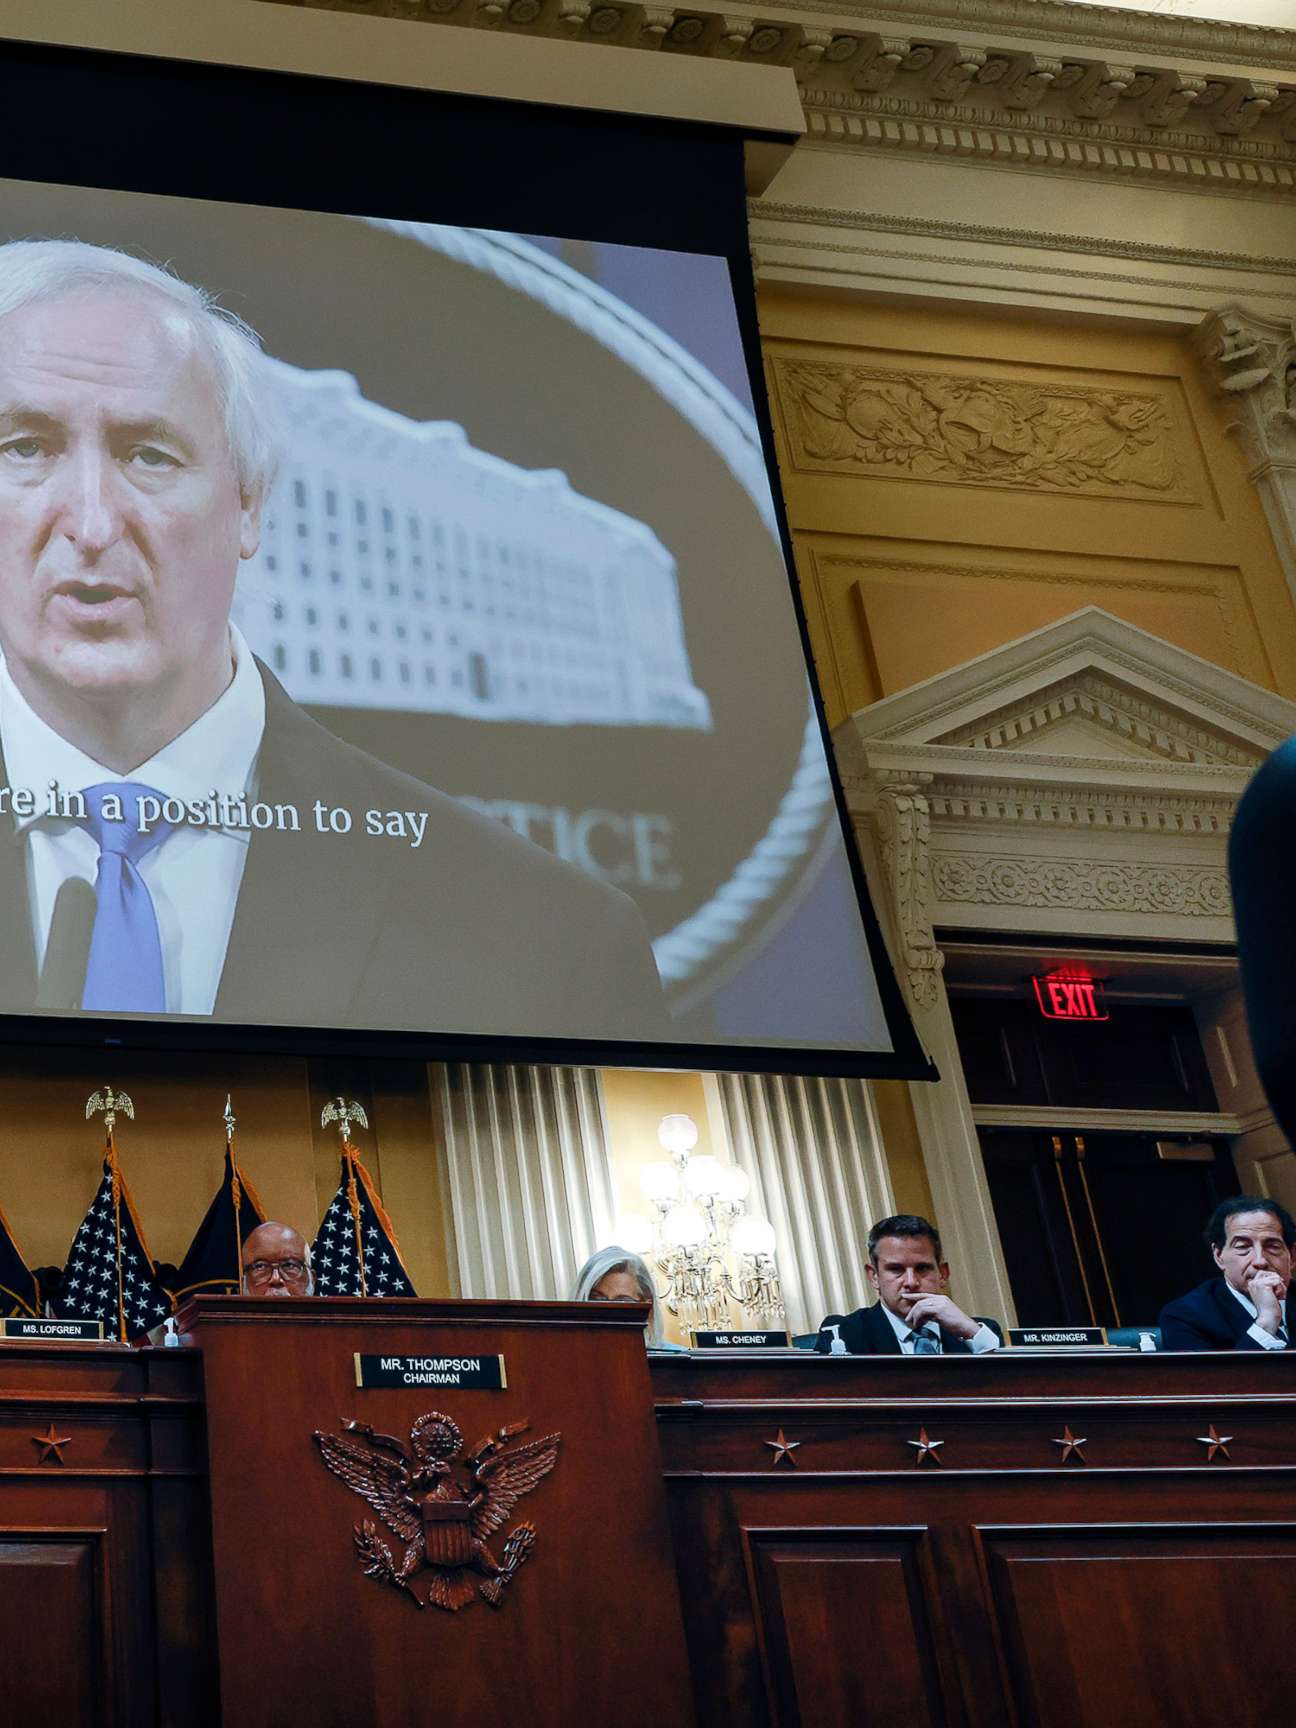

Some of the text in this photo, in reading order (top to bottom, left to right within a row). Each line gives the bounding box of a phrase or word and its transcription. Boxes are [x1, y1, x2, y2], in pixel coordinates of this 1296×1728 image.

[48, 780, 87, 818] in
[101, 793, 123, 820] a
[136, 790, 301, 832] position
[313, 800, 352, 833] to
[365, 808, 429, 848] say
[1047, 982, 1098, 1017] EXIT
[22, 1324, 82, 1335] MS. LOFGREN
[715, 1335, 767, 1345] MS. CHENEY
[1023, 1332, 1088, 1343] MR. KINZINGER
[380, 1358, 480, 1372] MR. THOMPSON
[403, 1372, 461, 1384] CHAIRMAN
